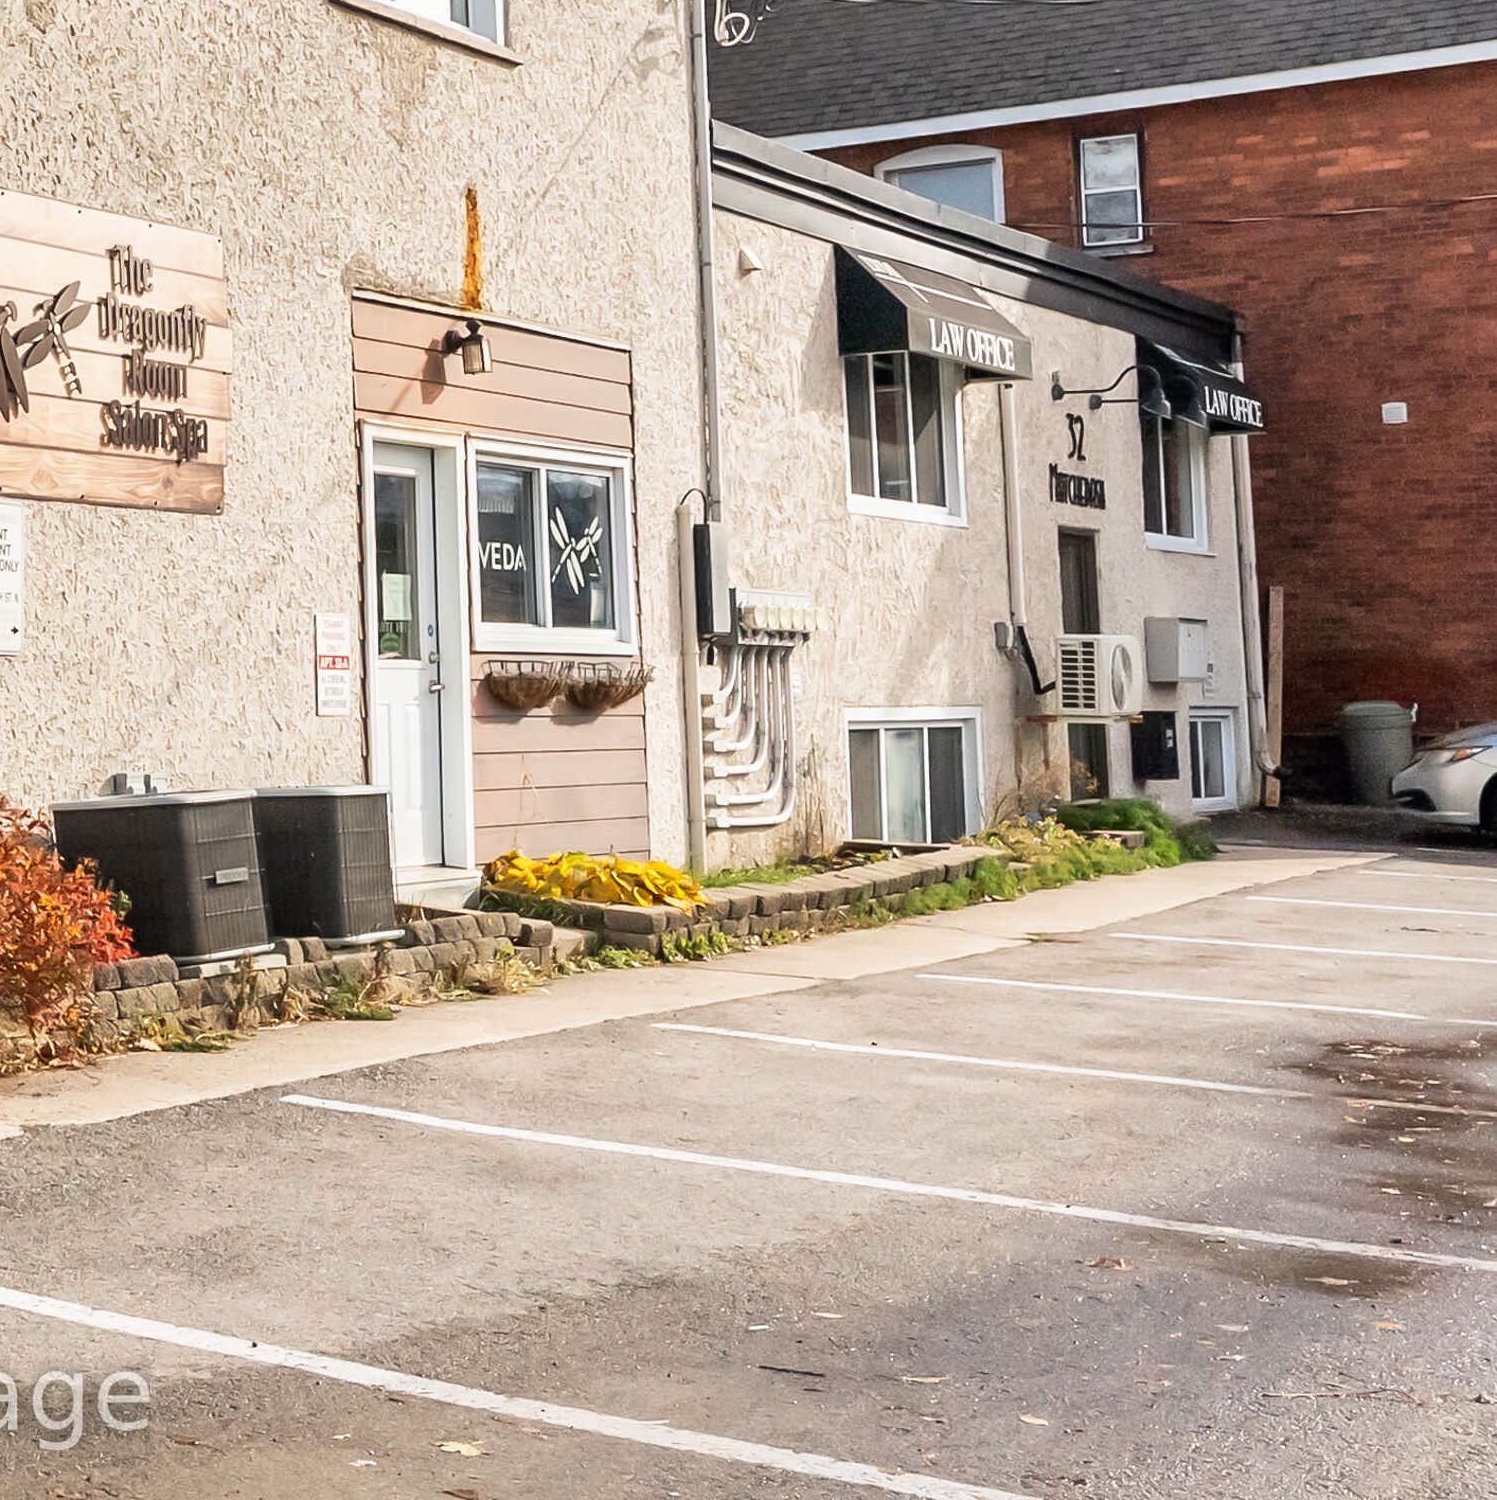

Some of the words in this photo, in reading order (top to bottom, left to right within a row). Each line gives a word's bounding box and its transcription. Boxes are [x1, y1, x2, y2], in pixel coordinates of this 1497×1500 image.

[107, 244, 153, 296] The
[99, 292, 207, 361] Dragonfly
[929, 318, 964, 357] LAW
[966, 328, 1016, 372] OFFICE
[124, 349, 187, 401] Room
[101, 400, 167, 453] Salon
[170, 408, 208, 462] Spa
[1204, 386, 1228, 416] LAW
[1230, 394, 1263, 428] OFFICE
[1066, 413, 1086, 461] 32
[0, 559, 19, 572] ONLY
